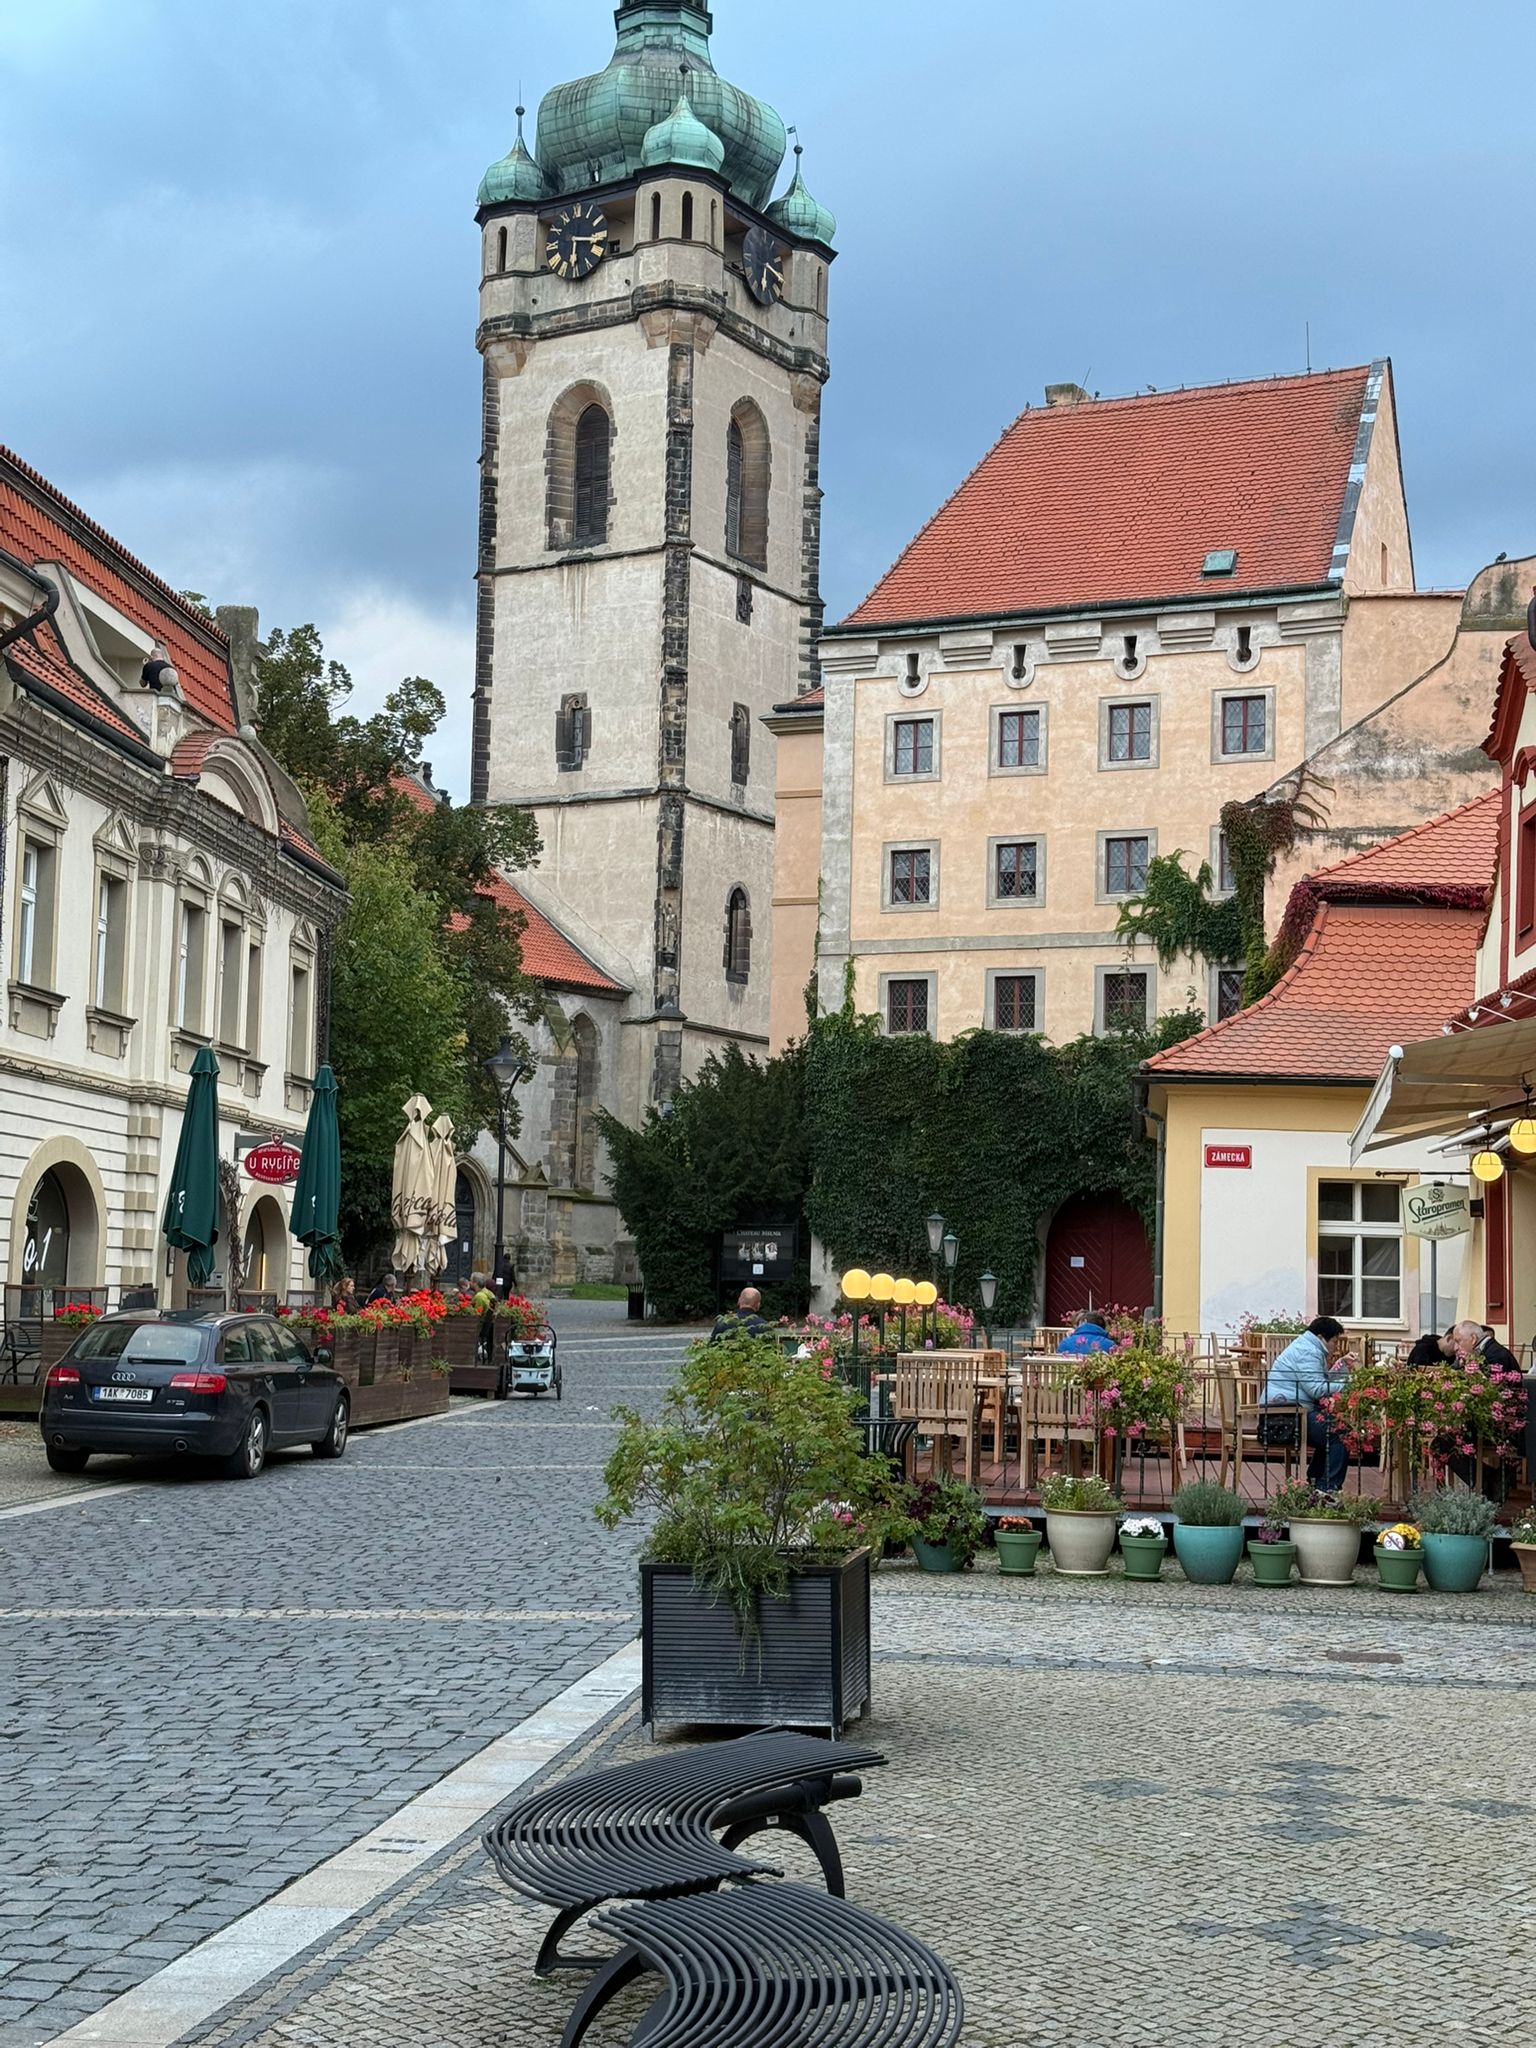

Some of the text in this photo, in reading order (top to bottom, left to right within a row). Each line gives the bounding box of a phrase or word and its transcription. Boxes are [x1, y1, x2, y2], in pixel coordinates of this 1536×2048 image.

[1211, 1151, 1245, 1162] ZÁMECKÁ
[249, 1157, 257, 1169] U
[1408, 1196, 1467, 1224] Staropramen
[101, 1388, 149, 1400] 1AK 7085
